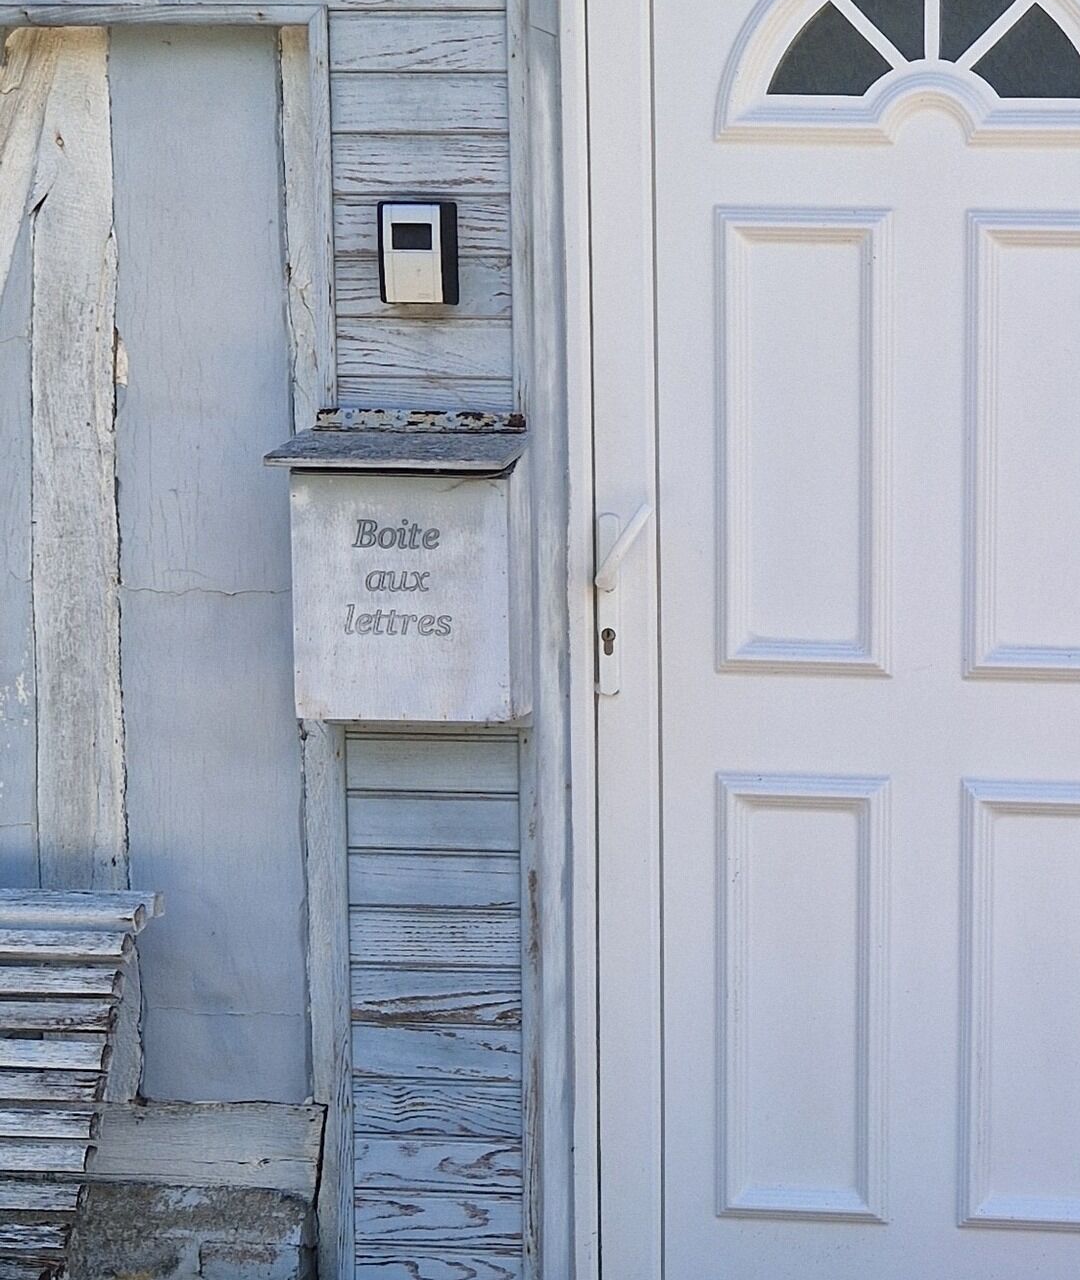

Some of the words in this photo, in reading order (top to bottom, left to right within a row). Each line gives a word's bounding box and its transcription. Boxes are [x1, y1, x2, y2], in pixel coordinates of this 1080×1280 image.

[351, 518, 441, 550] Boite
[364, 569, 431, 593] aux
[343, 603, 453, 637] lettres
